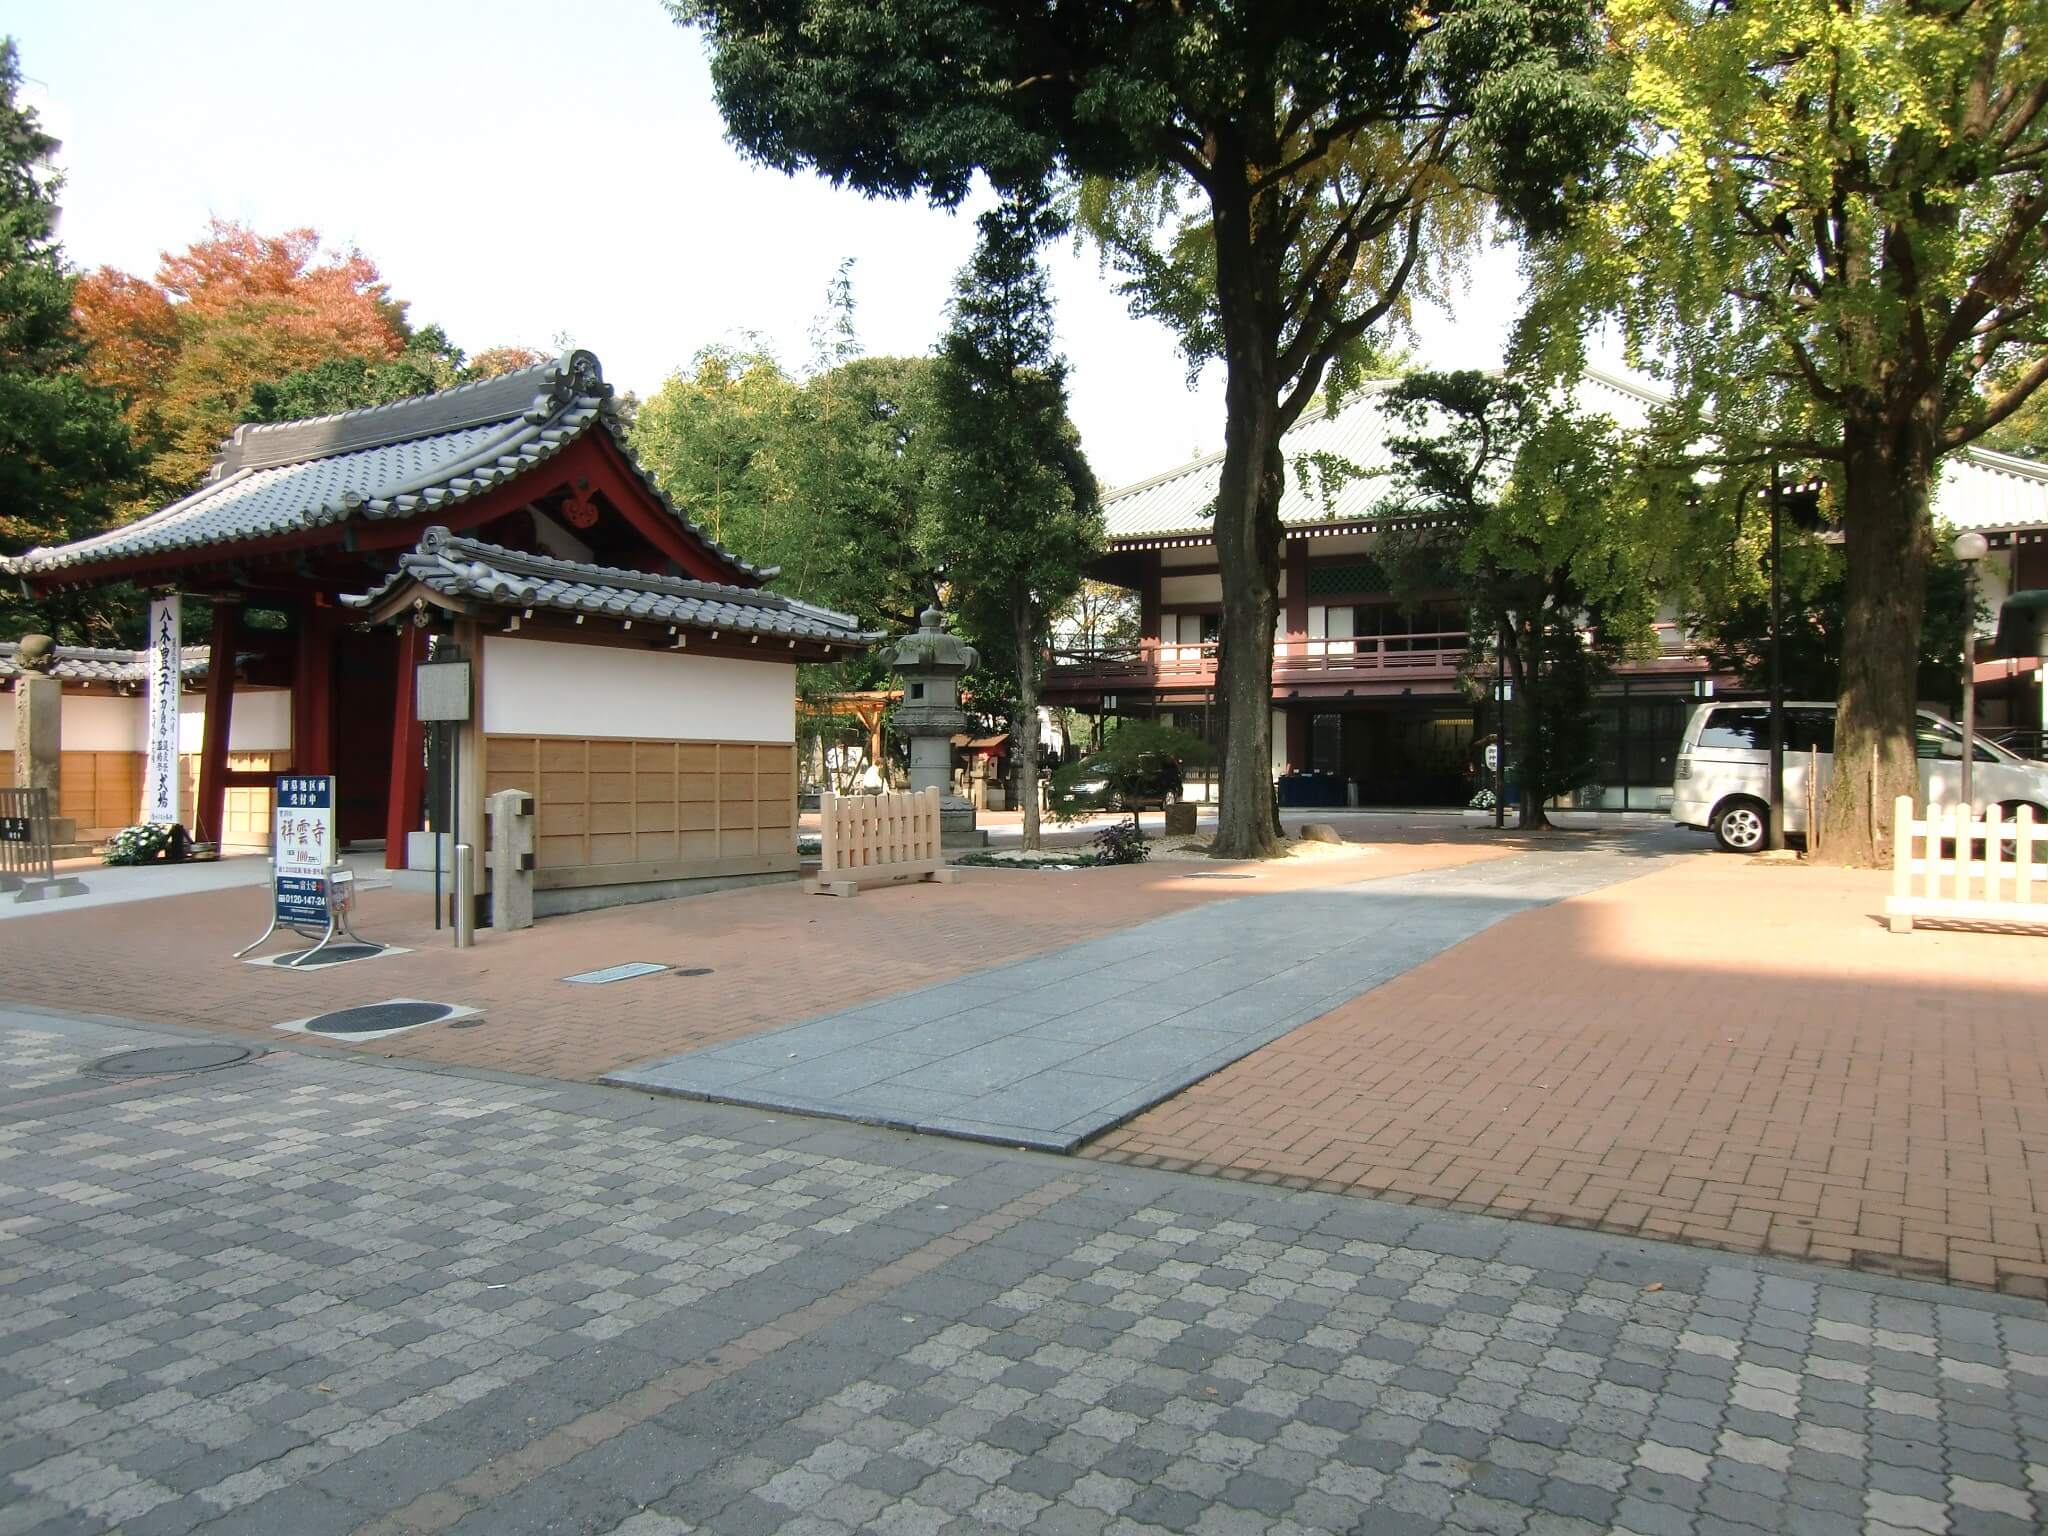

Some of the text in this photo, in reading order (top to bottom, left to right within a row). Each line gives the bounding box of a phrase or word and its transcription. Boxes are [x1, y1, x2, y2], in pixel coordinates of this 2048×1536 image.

[291, 793, 316, 805] 受付中
[281, 818, 326, 846] 祥雲寺
